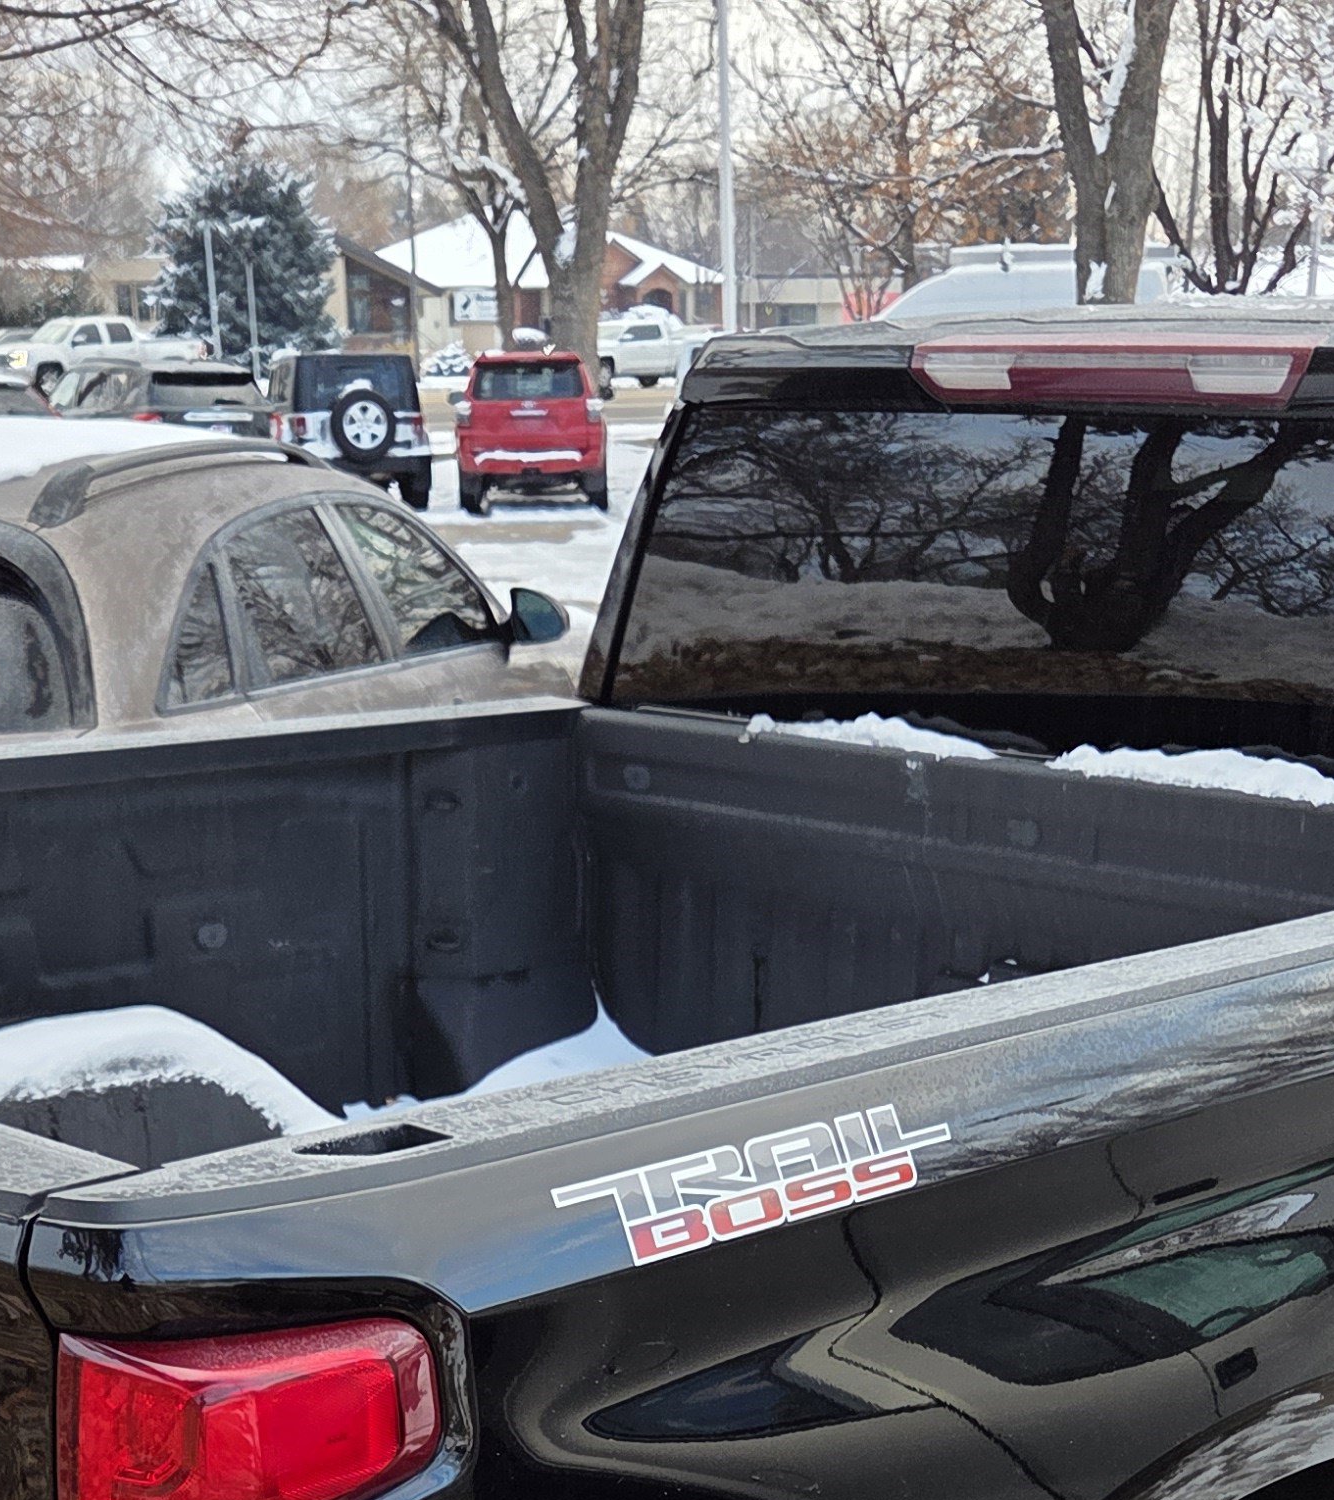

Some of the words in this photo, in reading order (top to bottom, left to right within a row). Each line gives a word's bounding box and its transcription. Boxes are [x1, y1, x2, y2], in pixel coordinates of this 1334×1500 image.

[534, 1011, 949, 1106] CHEVROLET
[550, 1104, 952, 1222] TRAIL
[629, 1150, 918, 1266] BOSS
